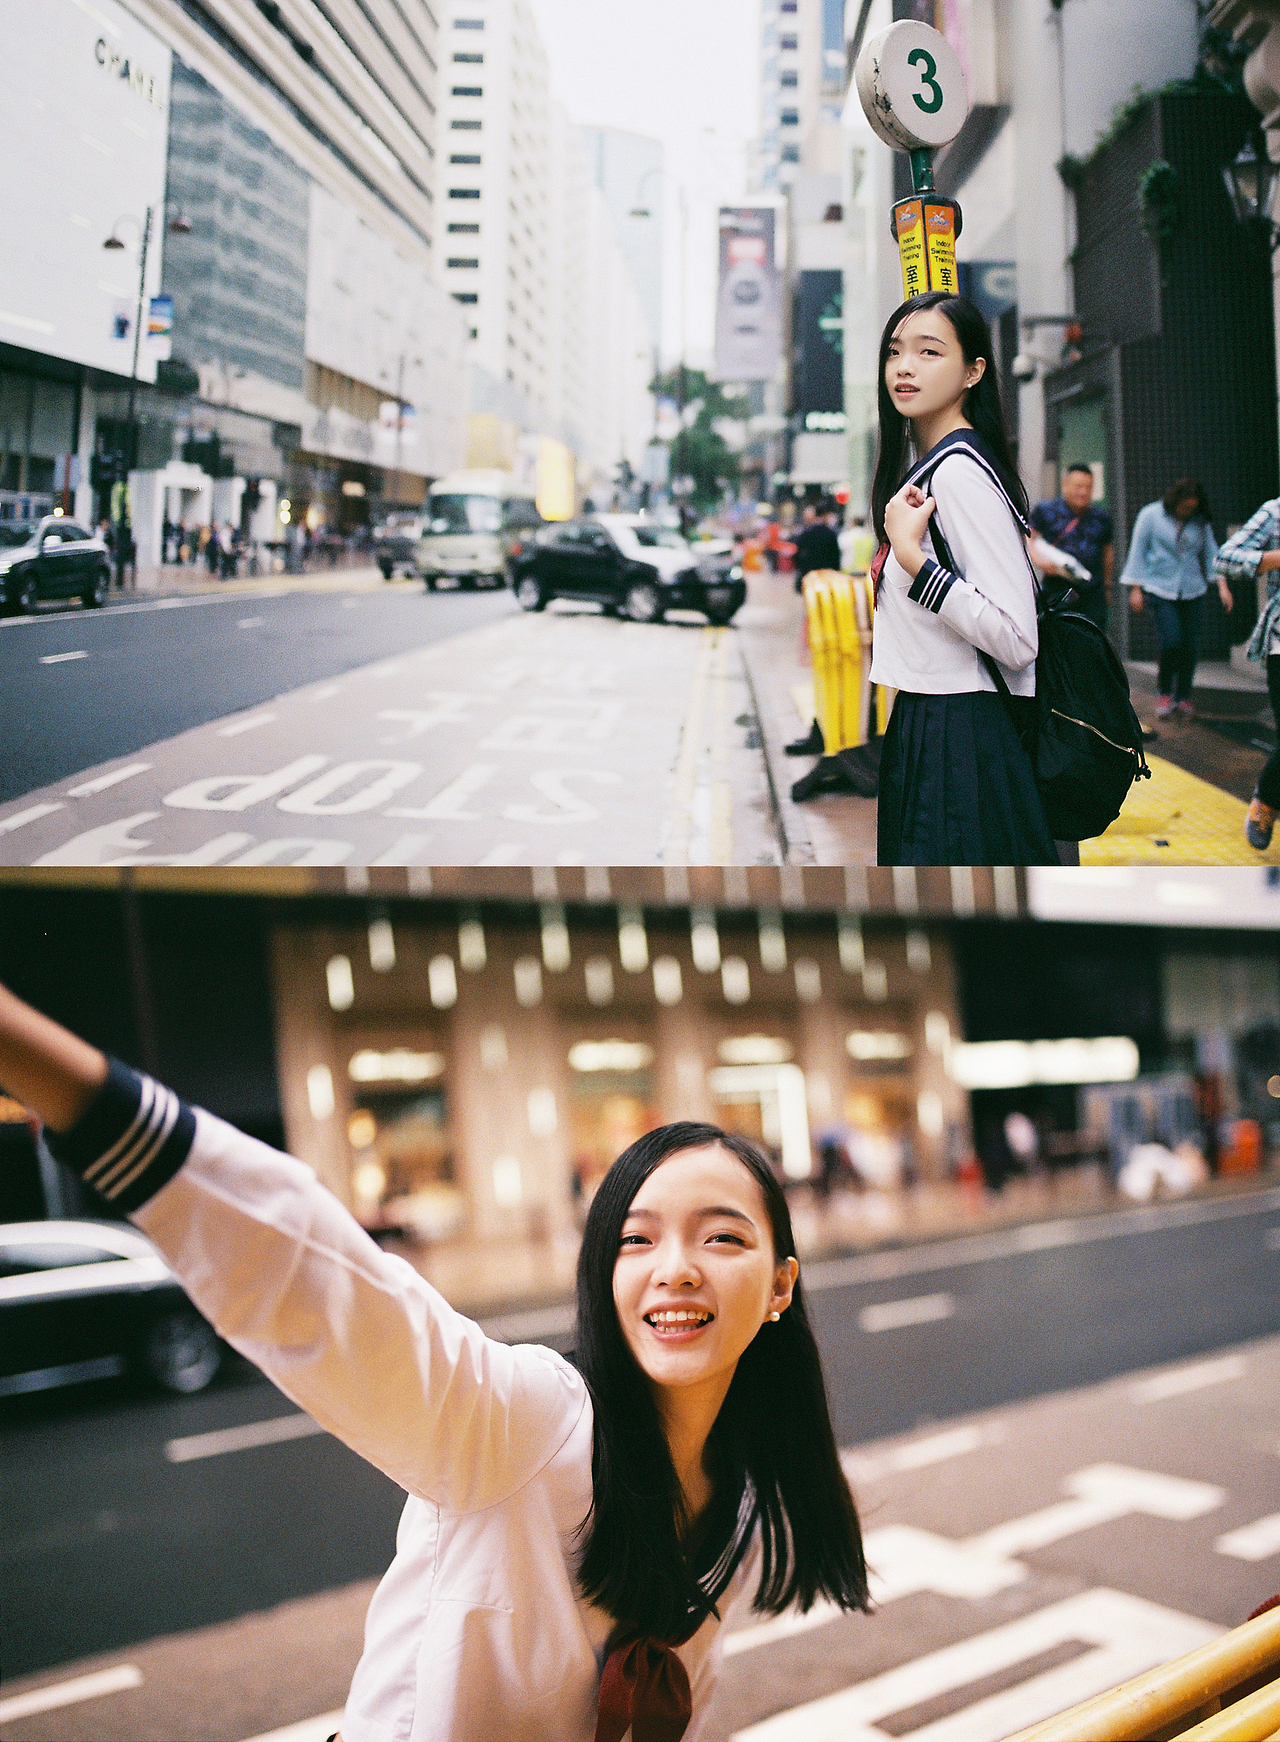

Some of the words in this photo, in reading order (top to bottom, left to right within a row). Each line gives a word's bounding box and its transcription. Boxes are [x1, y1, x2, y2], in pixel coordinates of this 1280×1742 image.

[94, 38, 164, 112] CHANE
[907, 48, 944, 114] 3
[162, 755, 623, 825] STOP
